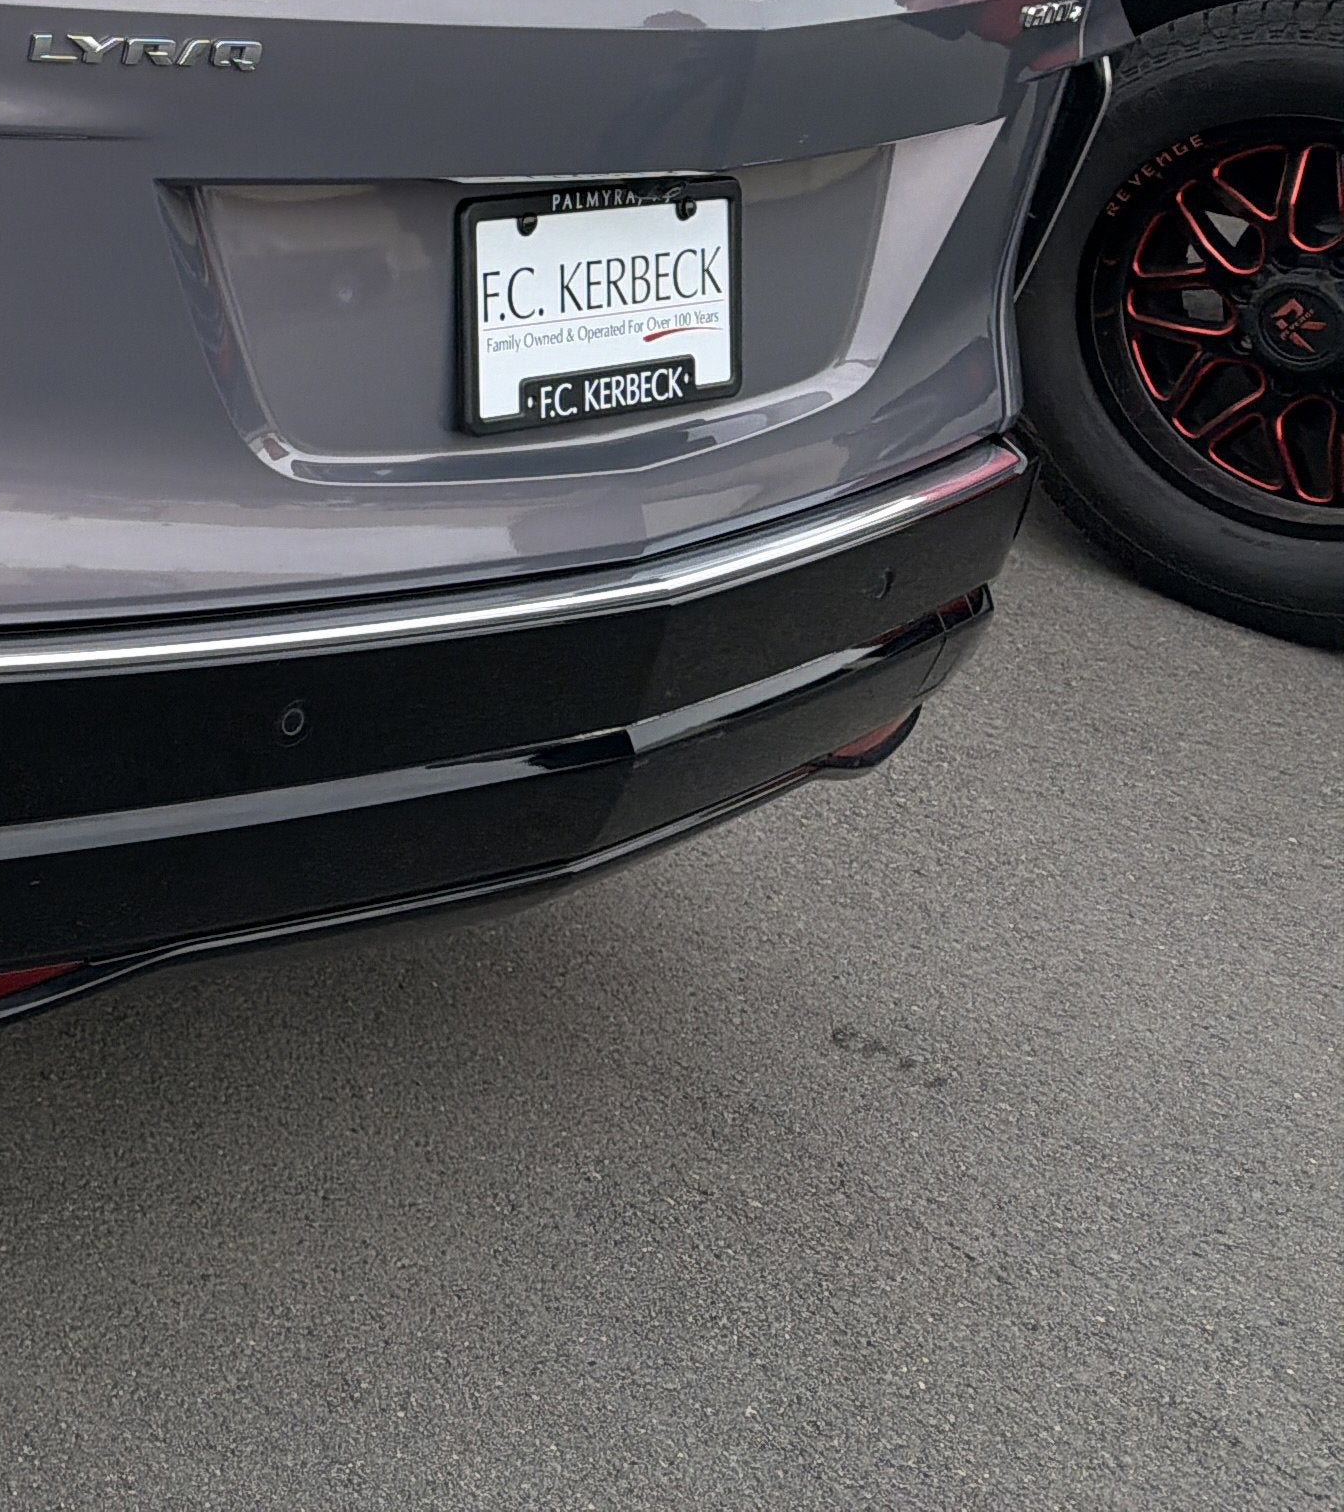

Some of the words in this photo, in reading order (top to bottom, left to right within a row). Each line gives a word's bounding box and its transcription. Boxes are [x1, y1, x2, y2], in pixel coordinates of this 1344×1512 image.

[27, 32, 263, 72] LYRIQ
[1105, 133, 1205, 218] REVENGE
[481, 266, 544, 324] F.C.
[559, 246, 723, 314] KERBECK
[486, 333, 522, 354] Family
[523, 329, 564, 349] Owned
[566, 326, 575, 343] &
[577, 320, 626, 344] Operated
[627, 318, 644, 334] For
[646, 316, 672, 333] Over
[673, 312, 692, 329] 100
[694, 310, 720, 327] Years
[540, 383, 578, 420] F.C.
[584, 367, 685, 413] KERBECK
